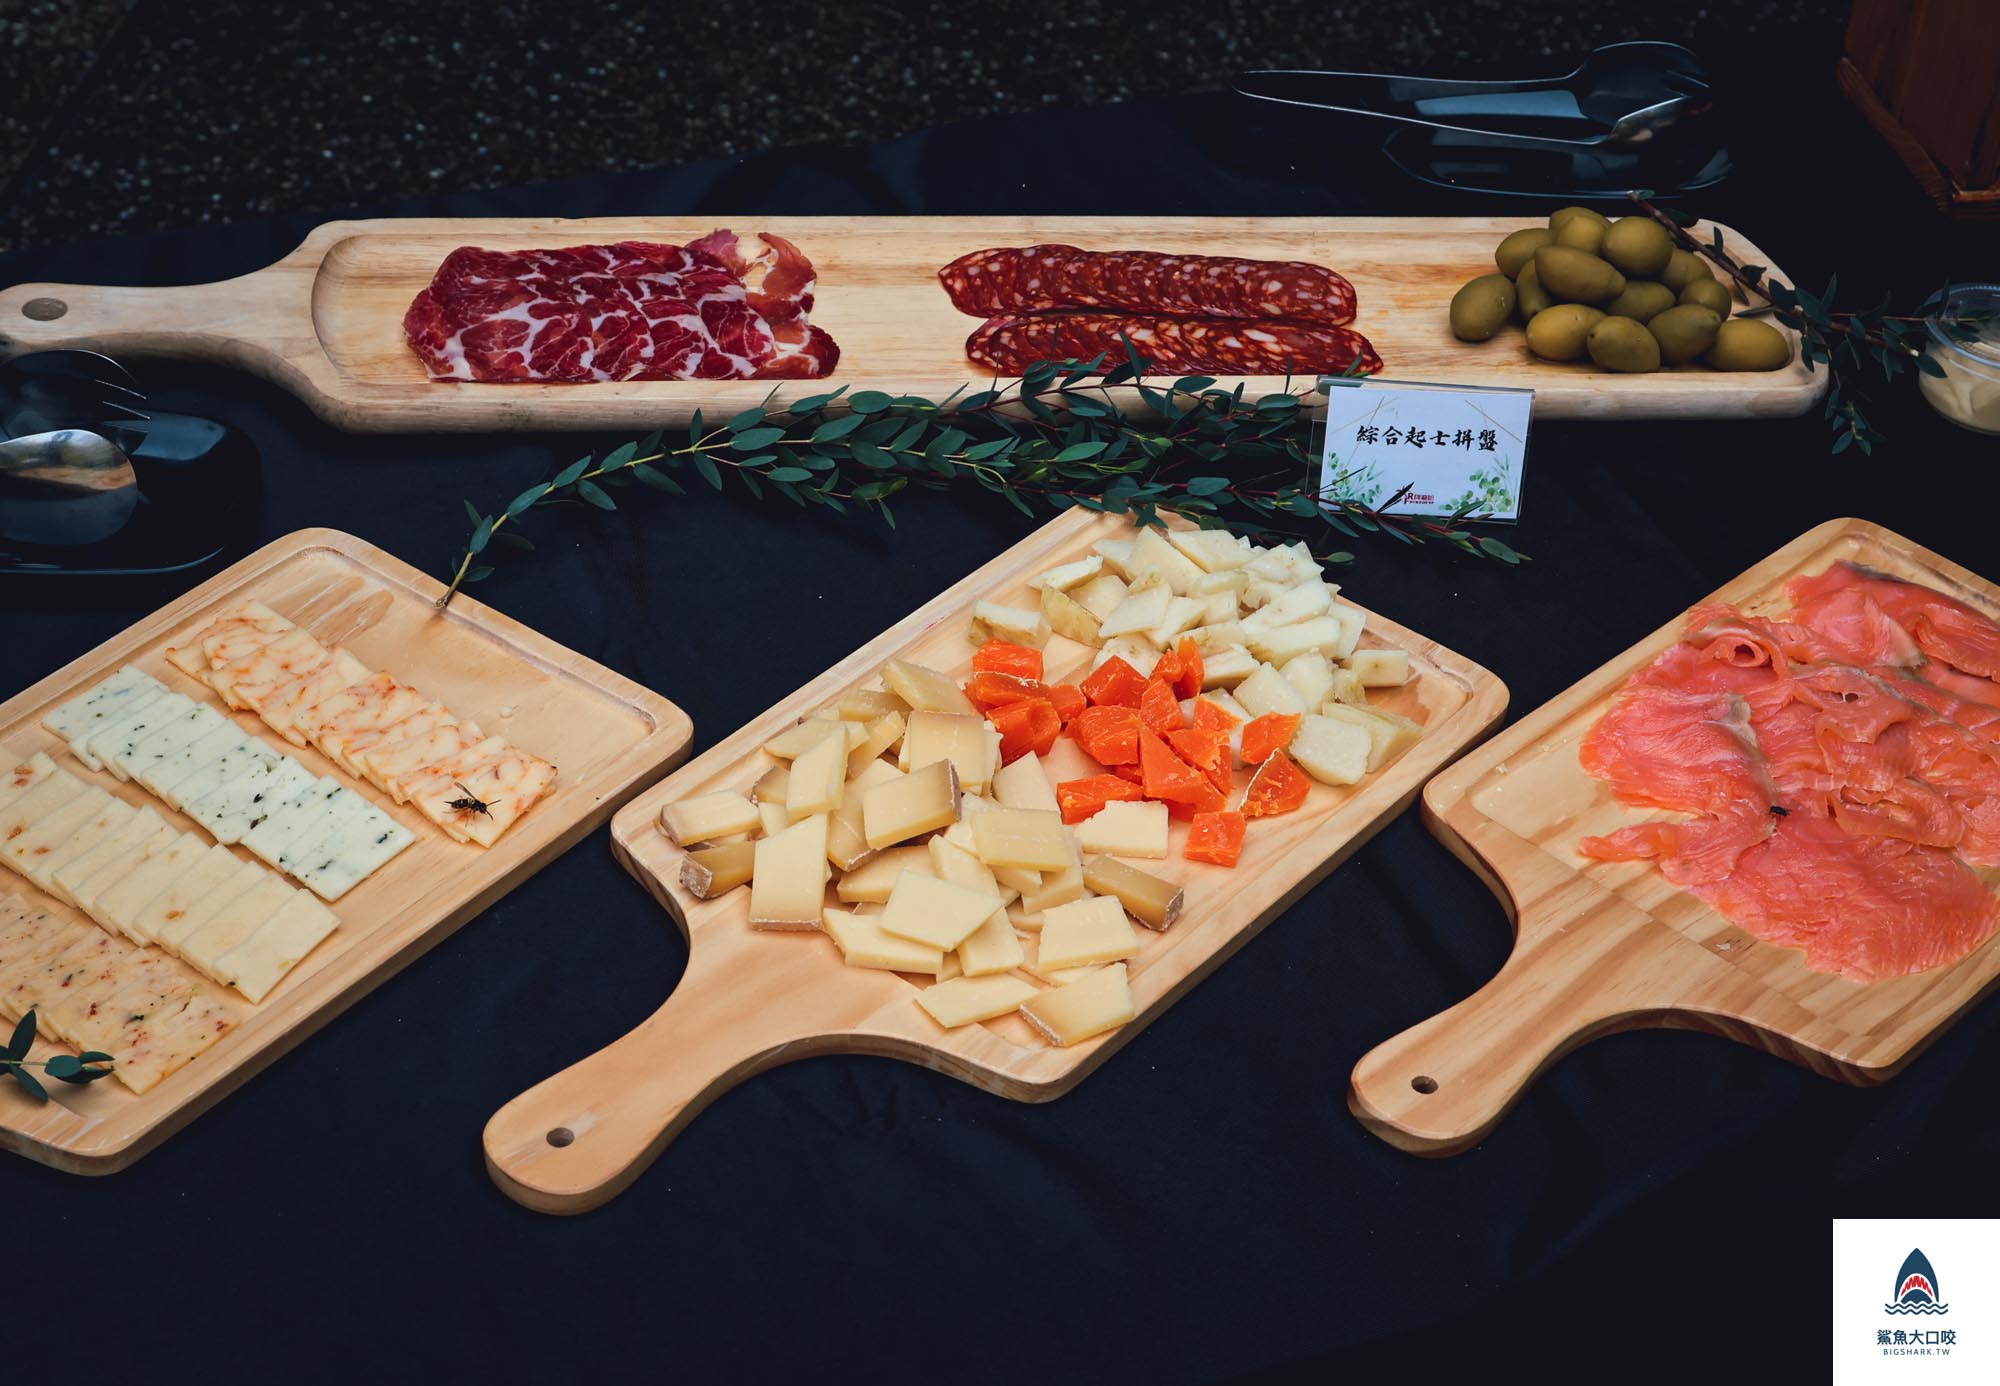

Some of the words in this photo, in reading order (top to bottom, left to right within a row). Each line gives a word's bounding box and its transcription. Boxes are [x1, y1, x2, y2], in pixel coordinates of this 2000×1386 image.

[1356, 425, 1498, 451] 綜合起士拼盤
